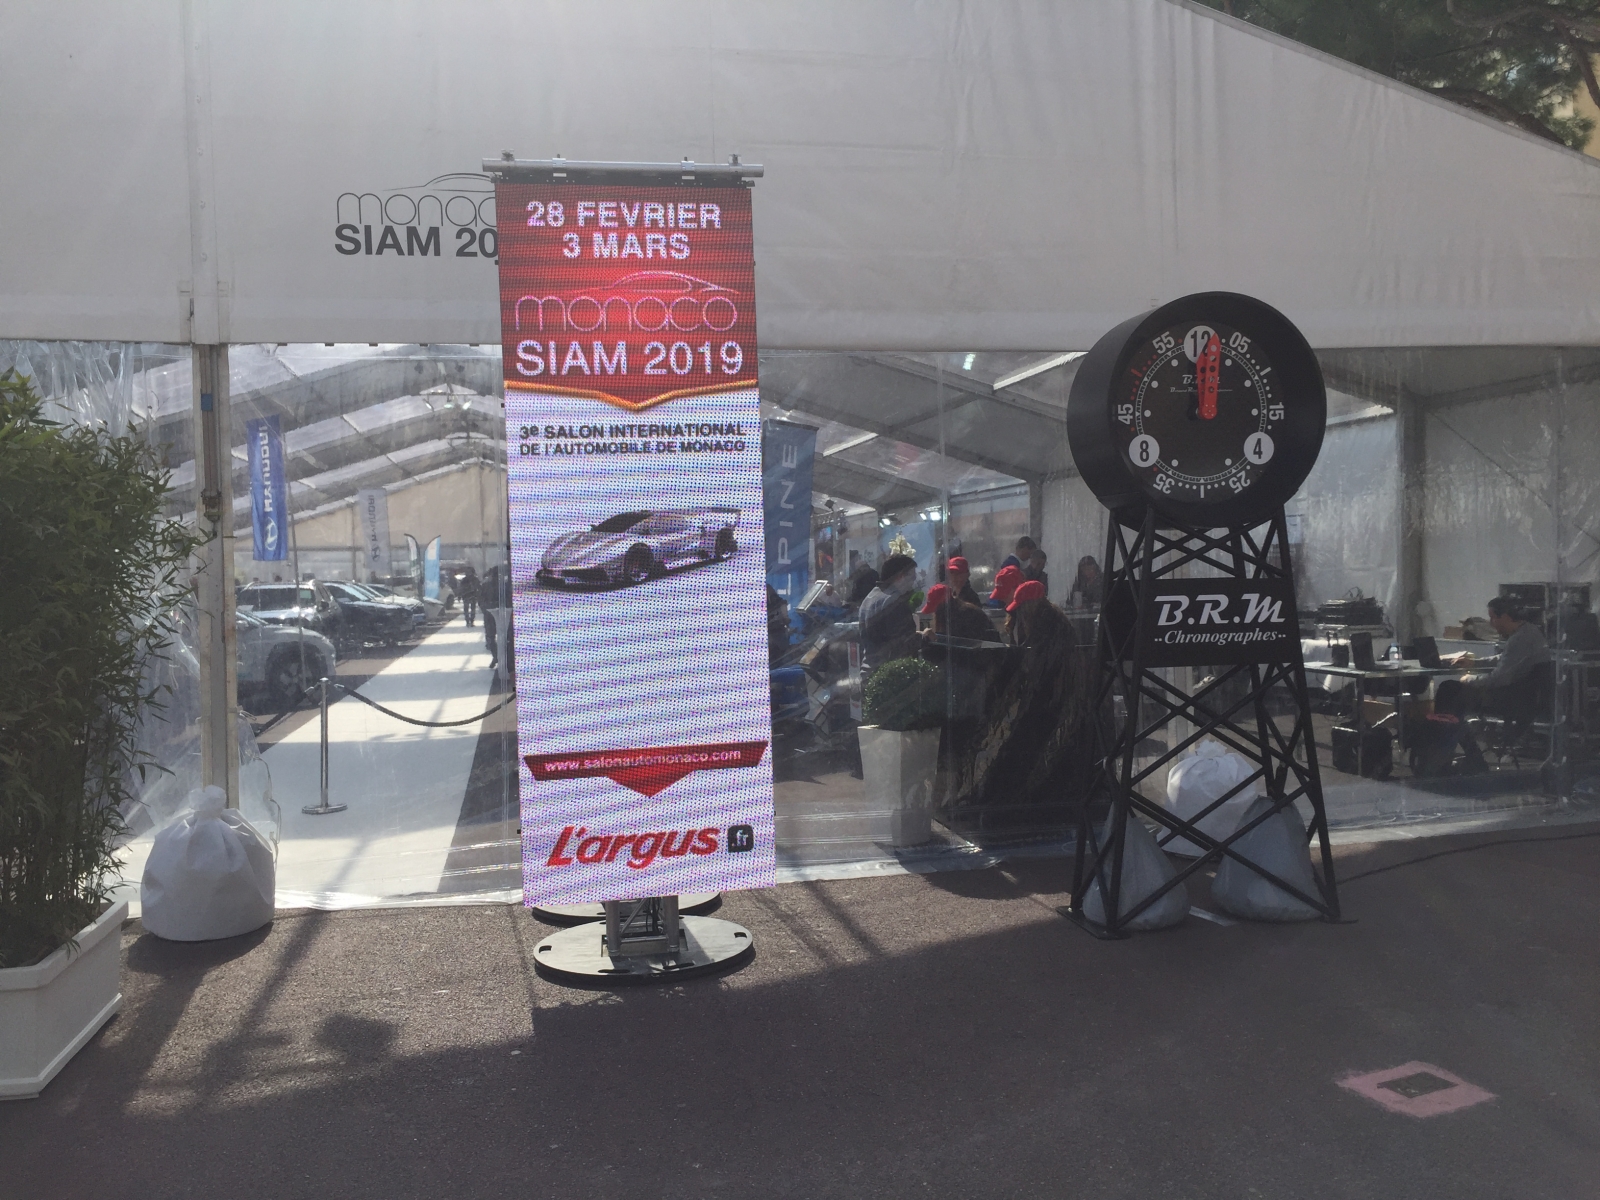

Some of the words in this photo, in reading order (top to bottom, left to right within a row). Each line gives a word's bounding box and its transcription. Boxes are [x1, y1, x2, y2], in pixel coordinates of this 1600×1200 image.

[336, 192, 497, 228] monac
[526, 201, 565, 227] 28
[578, 201, 721, 229] FEVRIER
[334, 223, 442, 257] SIAM
[455, 227, 498, 259] 20
[563, 232, 581, 259] 3
[594, 232, 691, 260] MARS
[515, 295, 738, 332] monaco
[1153, 331, 1175, 355] 55
[1229, 332, 1252, 354] 05
[516, 340, 627, 376] SIAM
[644, 340, 743, 375] 2019
[1117, 404, 1134, 425] 45
[1269, 402, 1285, 421] 15
[544, 424, 604, 439] SALON
[610, 422, 747, 438] INTERNATIONAL
[520, 442, 541, 456] DE
[656, 441, 677, 454] DE
[681, 440, 746, 453] MONACO
[1139, 440, 1150, 463] 8
[1252, 437, 1263, 460] 4
[777, 444, 798, 611] LPINE
[1154, 593, 1286, 626] B.R.M
[544, 750, 742, 772] www.salonautomonaco.com
[546, 825, 721, 870] L'argus
